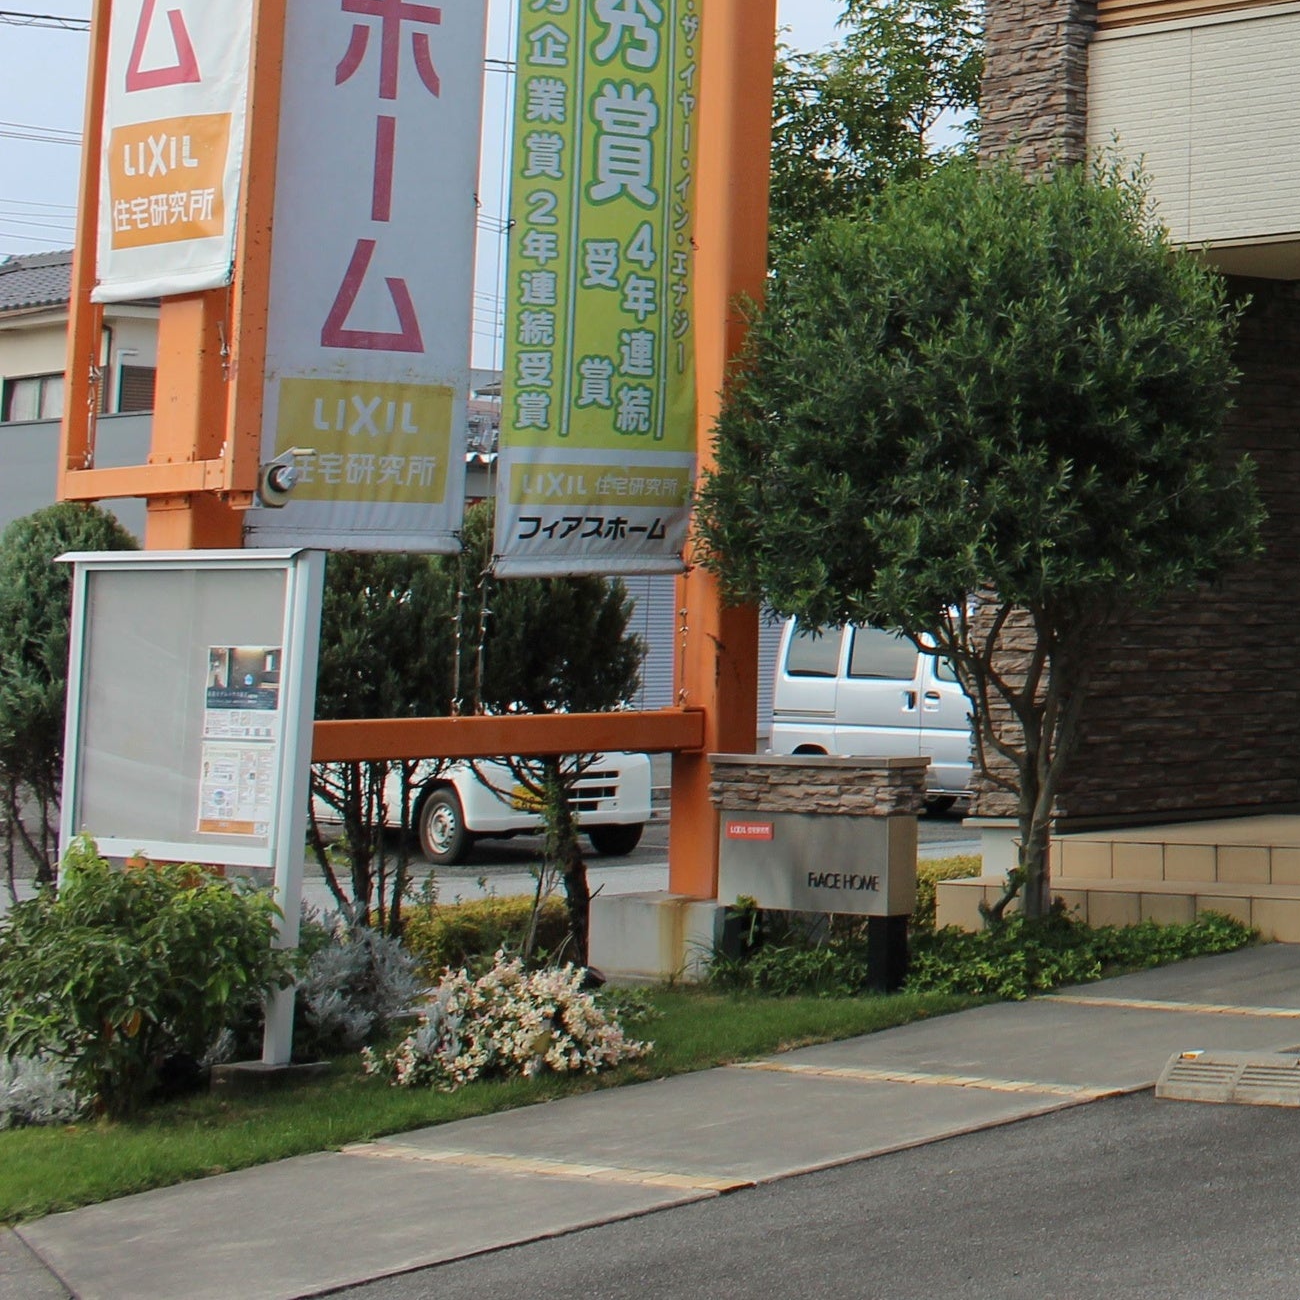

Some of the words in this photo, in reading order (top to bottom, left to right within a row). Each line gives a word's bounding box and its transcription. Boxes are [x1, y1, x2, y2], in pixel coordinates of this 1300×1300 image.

[124, 133, 198, 178] LIXIL
[113, 187, 216, 233] 住宅研究所
[313, 395, 419, 437] LIXIL
[522, 472, 588, 497] LIXIL
[594, 473, 678, 497] 住宅研究所
[518, 516, 666, 541] フィアスホーム
[843, 873, 880, 892] HOME
